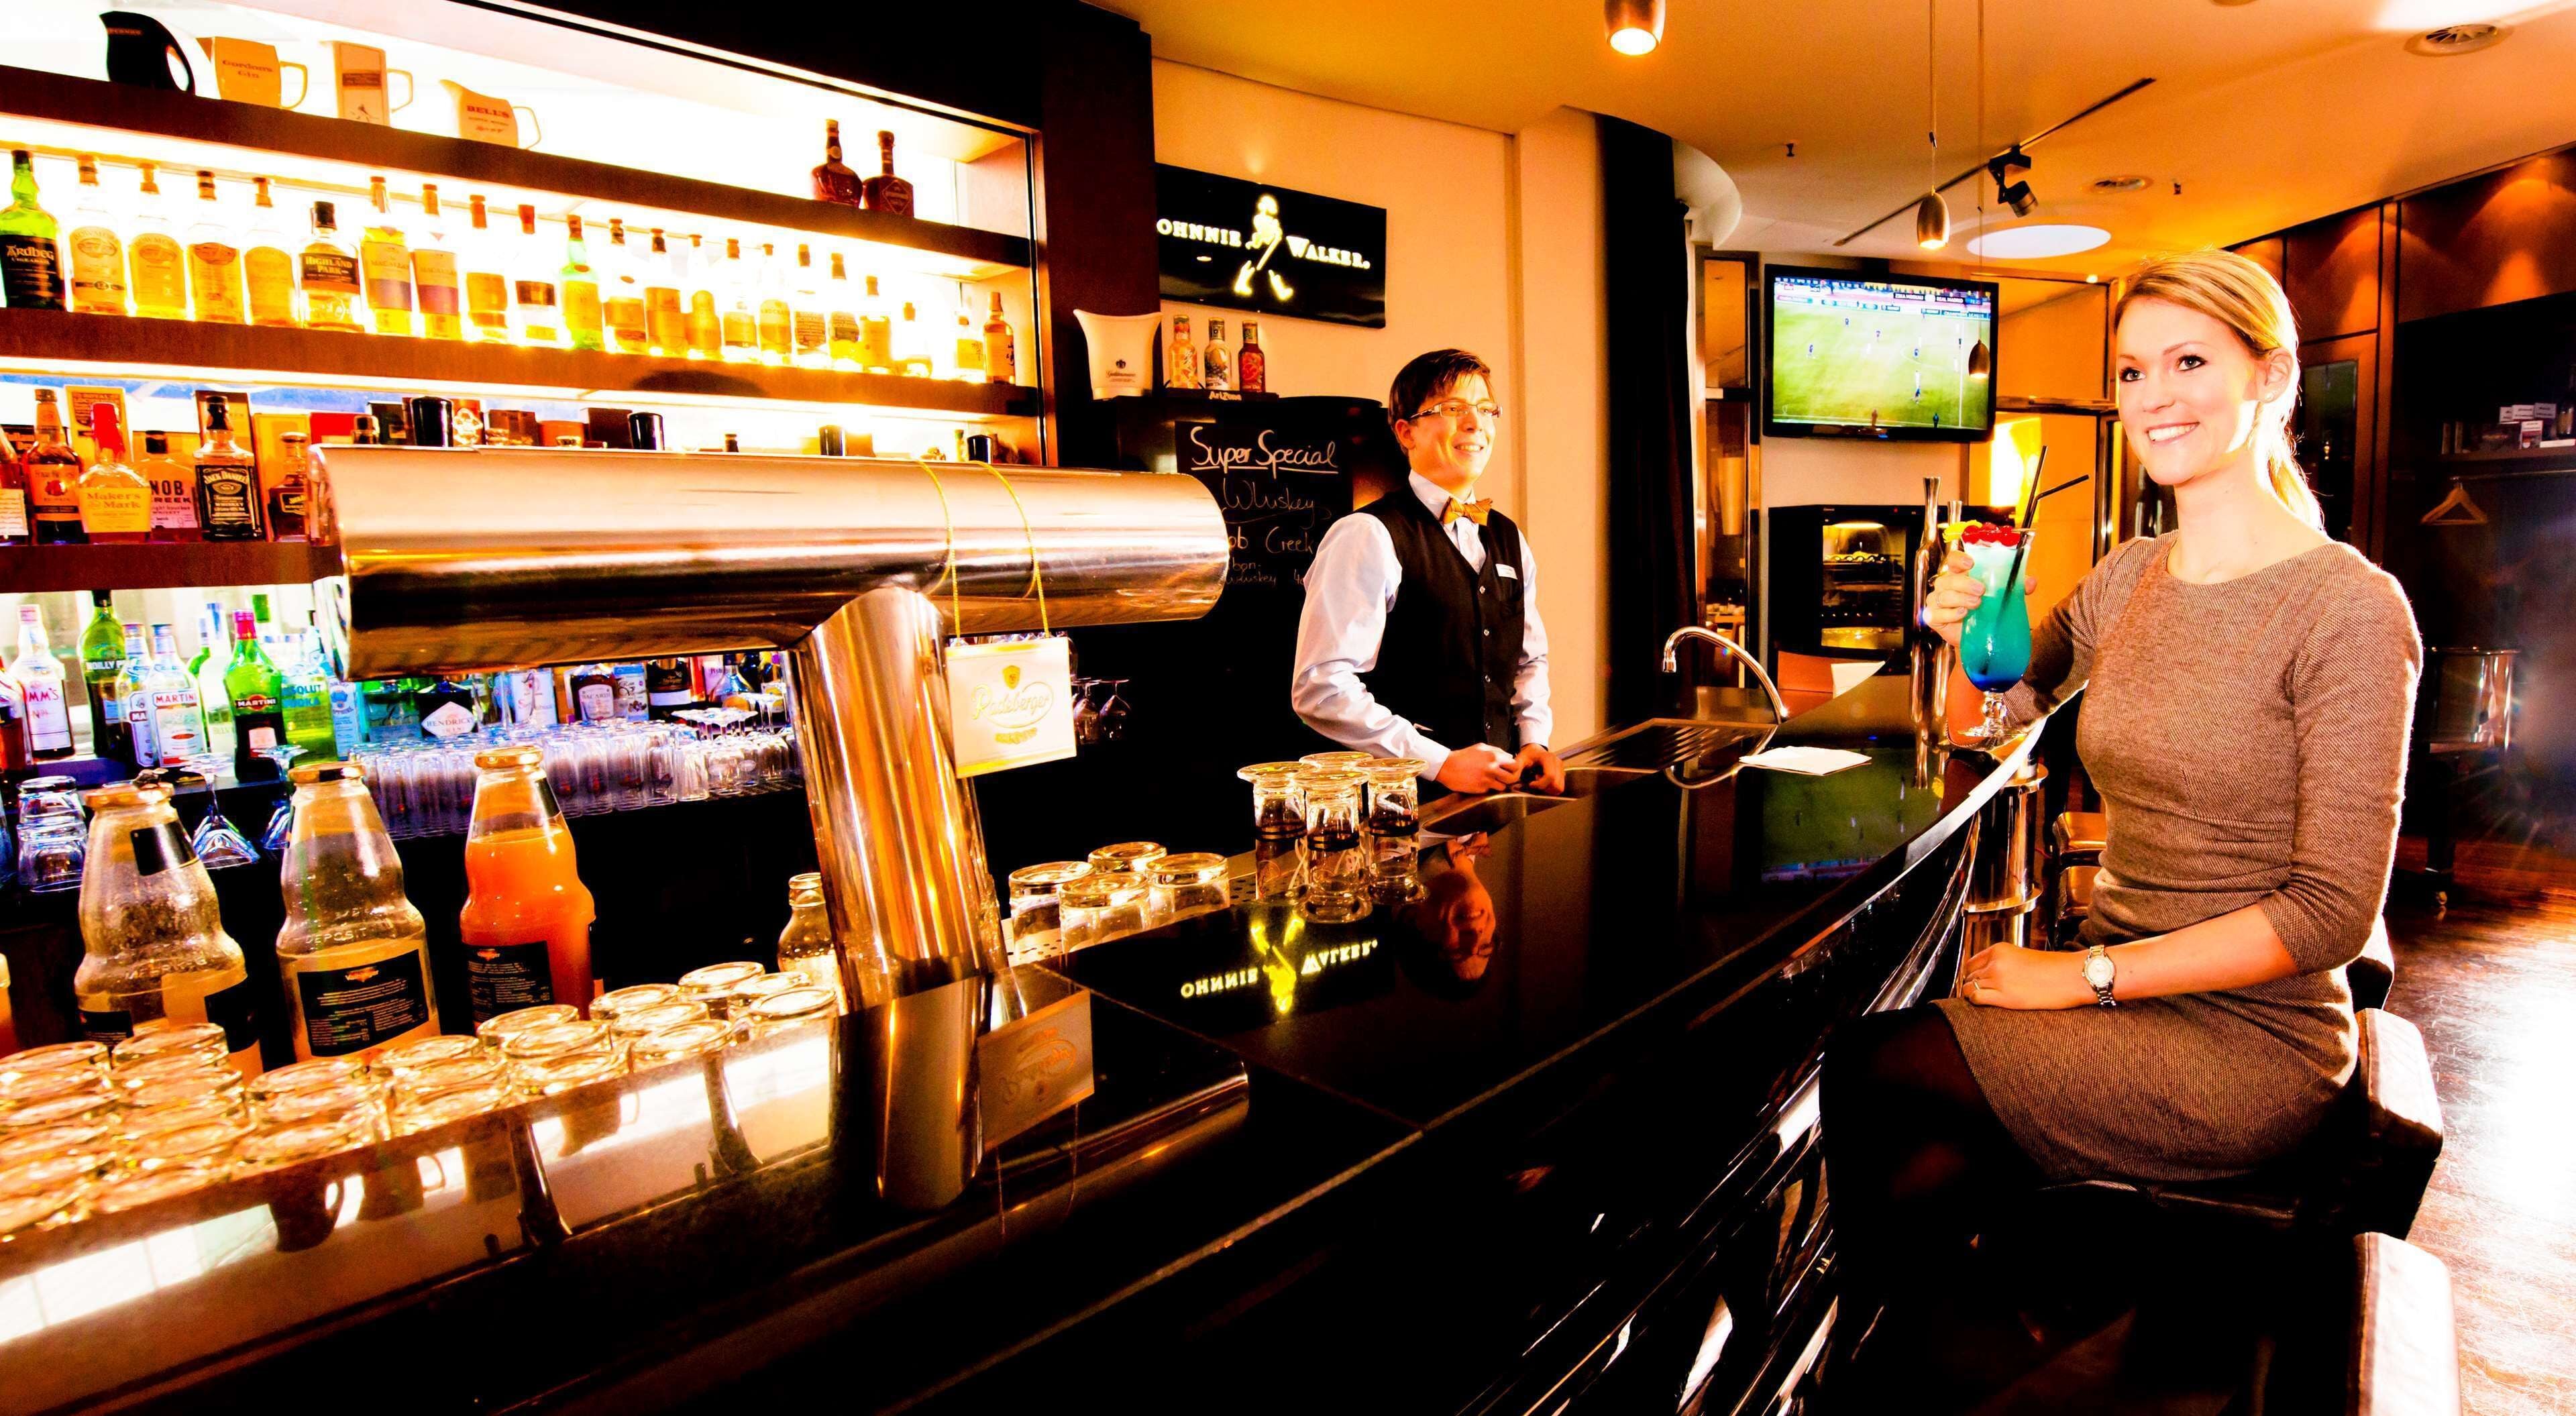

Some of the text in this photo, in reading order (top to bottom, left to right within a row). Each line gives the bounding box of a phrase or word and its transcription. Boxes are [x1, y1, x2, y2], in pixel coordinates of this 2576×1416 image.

[317, 265, 341, 275] PARK
[1190, 426, 1338, 479] Super Special
[203, 472, 222, 484] JACK
[87, 492, 141, 500] Maker's
[1265, 526, 1315, 555] Creek
[237, 698, 276, 707] MARTINI
